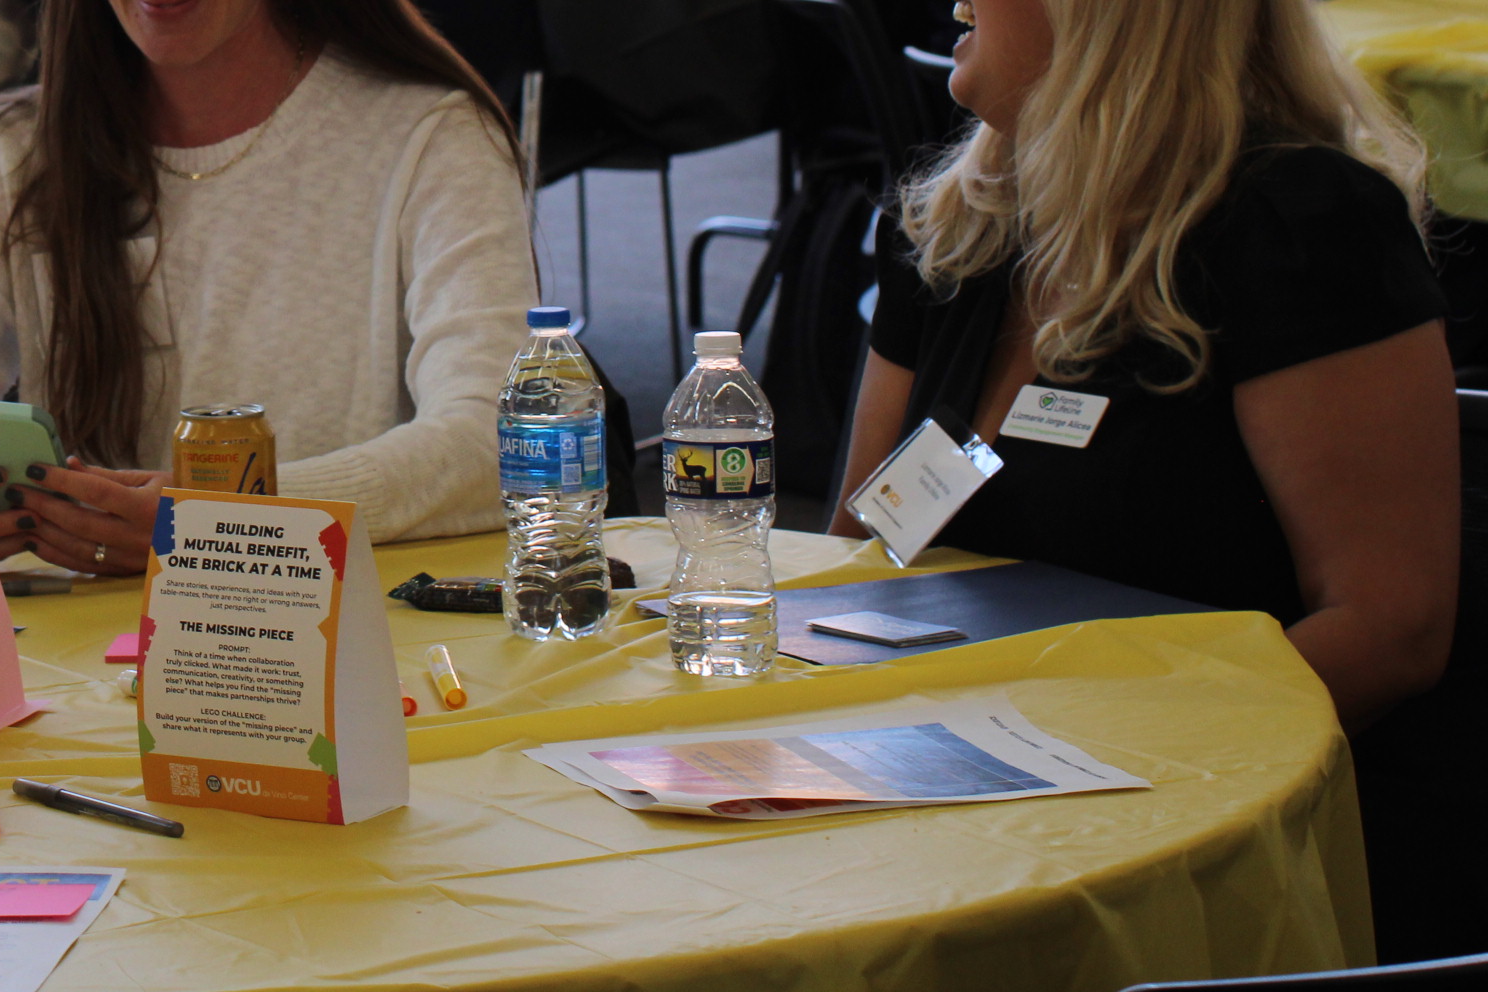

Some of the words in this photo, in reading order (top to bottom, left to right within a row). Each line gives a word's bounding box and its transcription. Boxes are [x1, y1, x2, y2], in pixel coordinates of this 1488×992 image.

[183, 452, 239, 463] TANGERINE
[216, 522, 284, 539] BUILDING
[184, 538, 243, 554] MUTUAL
[247, 543, 310, 562] BENEFIT,
[168, 555, 198, 569] ONE
[202, 558, 246, 573] BRICK
[248, 563, 269, 575] AT
[271, 564, 282, 577] A
[287, 565, 321, 580] TIME
[166, 579, 185, 587] Share
[267, 588, 284, 596] ideas
[160, 589, 200, 598] table-mates,
[202, 592, 220, 600] there
[243, 596, 259, 604] right
[269, 599, 290, 607] wrong
[180, 621, 203, 632] THE
[206, 623, 256, 638] MISSING
[259, 628, 294, 641] PIECE
[219, 644, 250, 653] PROMPT:
[174, 649, 193, 657] Think
[209, 652, 226, 661] time
[248, 657, 295, 667] collaboration
[166, 659, 182, 667] truly
[184, 660, 210, 669] clicked.
[212, 663, 231, 671] What
[283, 670, 301, 678] trust,
[163, 668, 219, 680] communication,
[221, 674, 255, 684] creativity,
[266, 677, 304, 688] something
[165, 677, 183, 687] else?
[185, 679, 204, 687] What
[205, 681, 225, 689] helps
[240, 683, 255, 692] find
[189, 688, 204, 696] that
[206, 691, 229, 699] makes
[230, 694, 275, 704] partnerships
[276, 696, 301, 706] thrive?
[156, 712, 174, 721] Build
[193, 717, 218, 725] version
[228, 720, 241, 728] the
[201, 708, 220, 716] LEGO
[221, 710, 266, 721] CHALLENGE:
[163, 723, 182, 731] share
[183, 725, 201, 733] what
[209, 728, 247, 737] represents
[248, 731, 265, 739] with
[266, 731, 282, 741] your
[283, 736, 306, 744] group.
[222, 776, 261, 796] VCU
